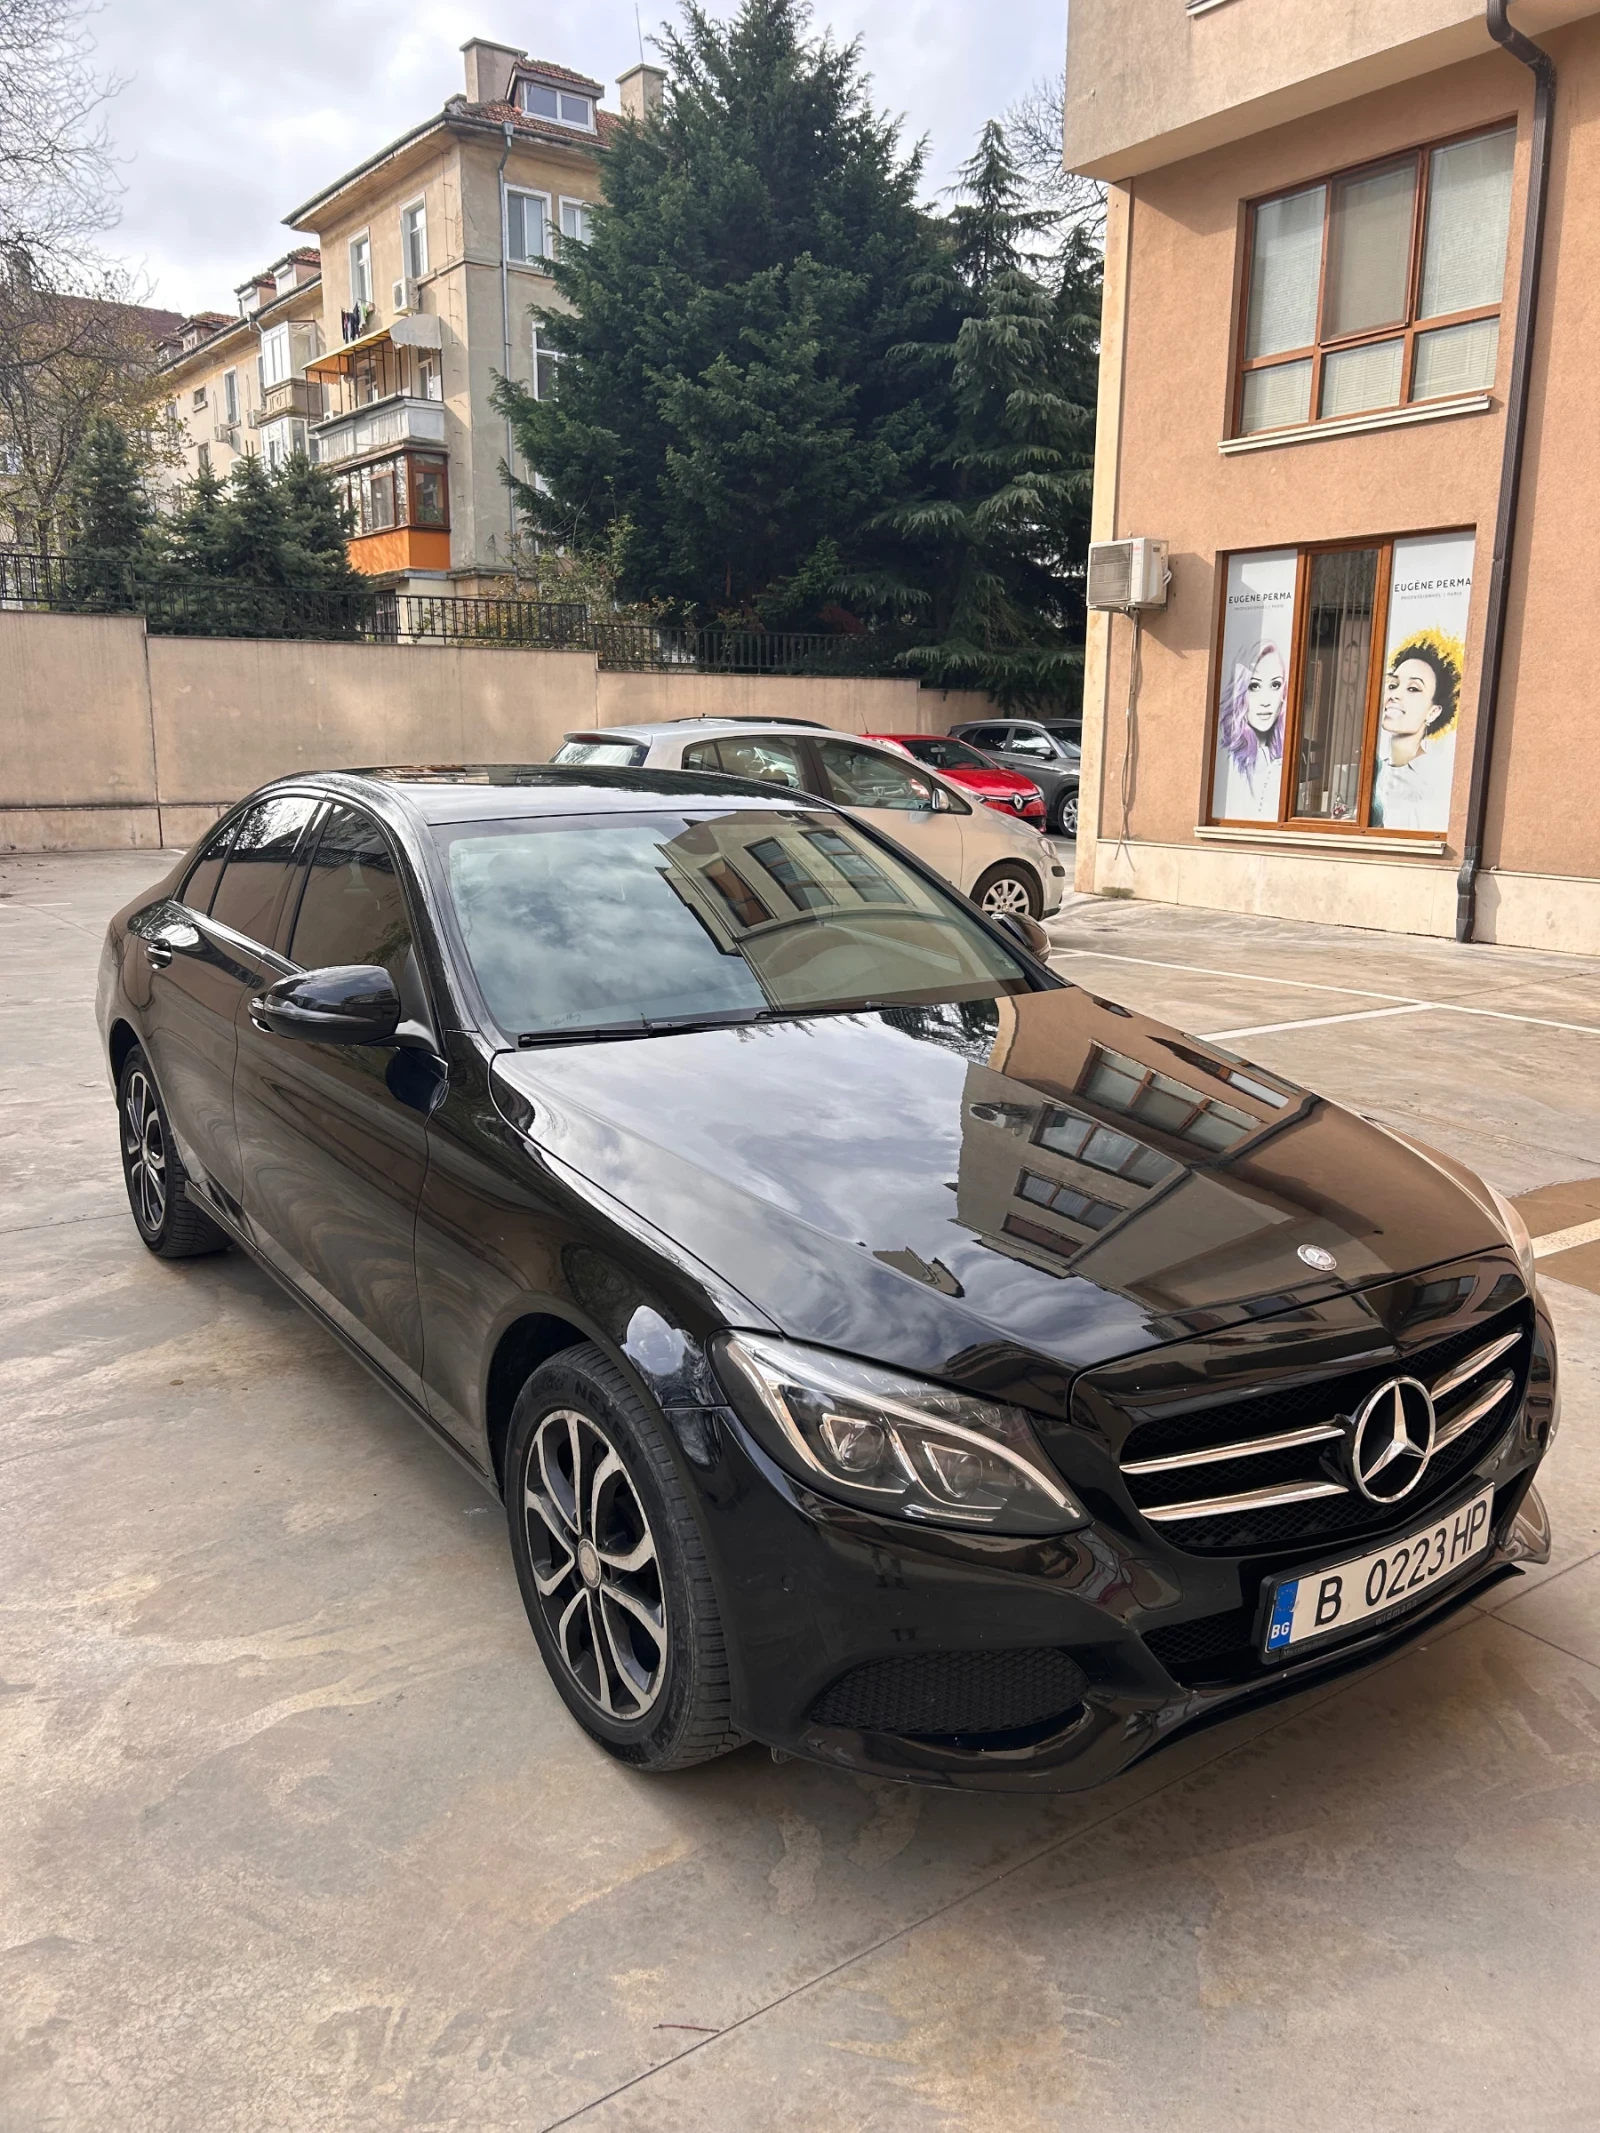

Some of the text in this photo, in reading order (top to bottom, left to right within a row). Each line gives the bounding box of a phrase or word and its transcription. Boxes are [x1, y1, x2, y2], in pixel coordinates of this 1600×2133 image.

[1394, 577, 1472, 592] EUGÈNE PERMA
[1228, 591, 1292, 604] EUGÈNE PERMA
[574, 1380, 638, 1466] NEXEN
[1314, 1575, 1343, 1628] B
[1365, 1527, 1447, 1607] 0223
[1449, 1499, 1488, 1563] HP
[1270, 1621, 1290, 1640] BG
